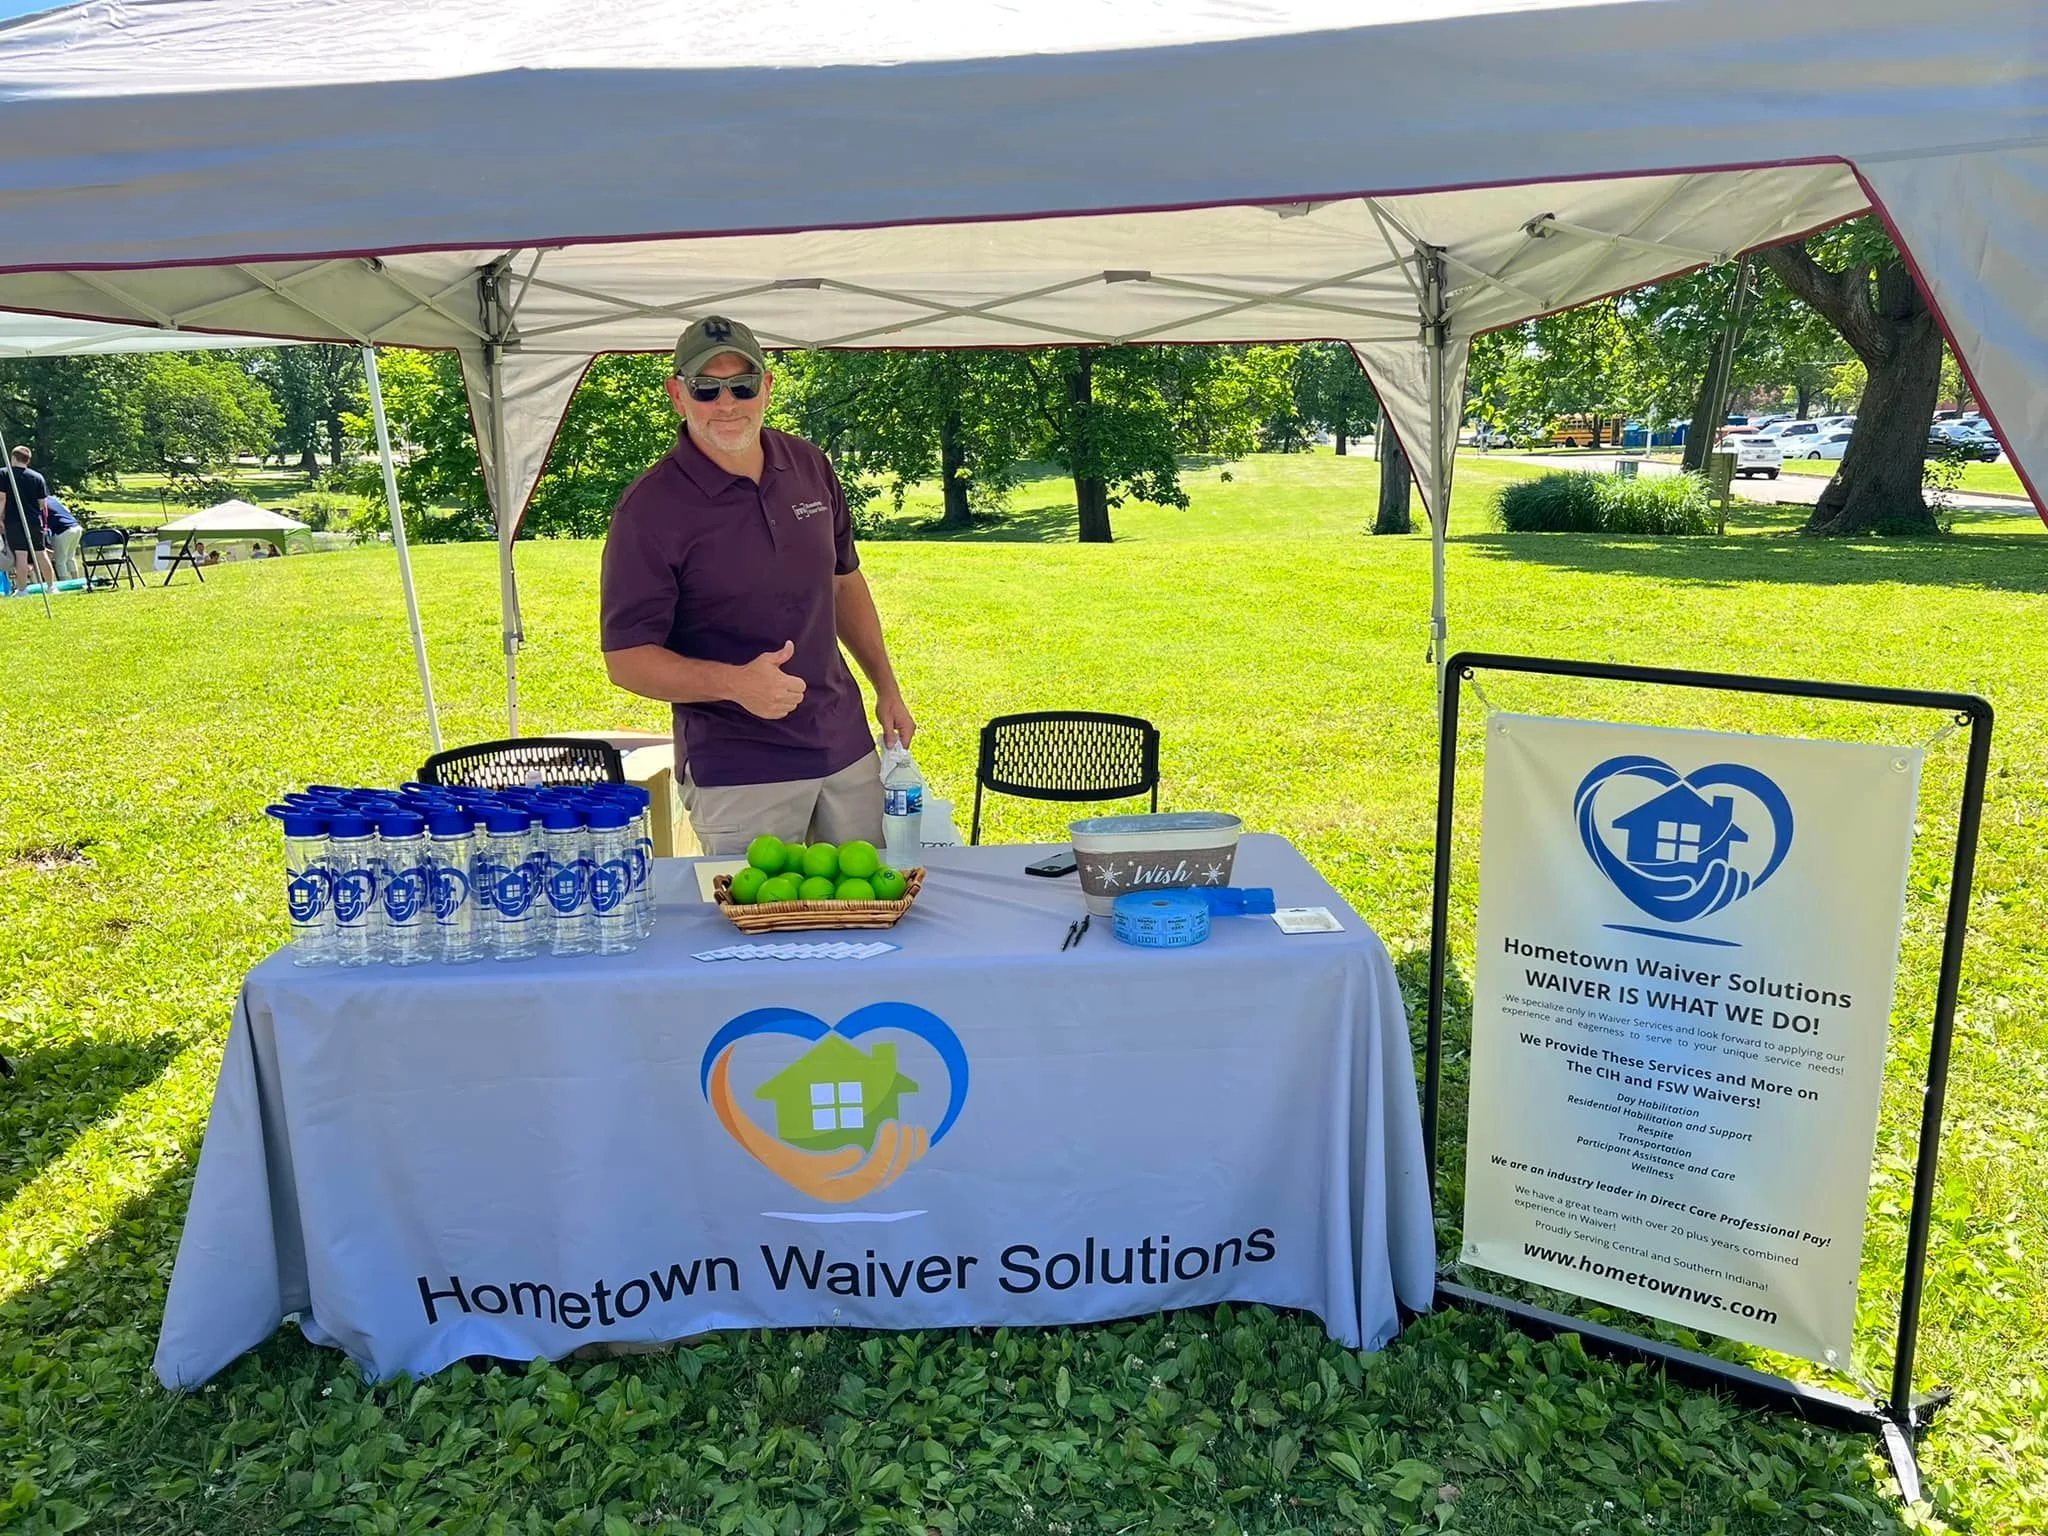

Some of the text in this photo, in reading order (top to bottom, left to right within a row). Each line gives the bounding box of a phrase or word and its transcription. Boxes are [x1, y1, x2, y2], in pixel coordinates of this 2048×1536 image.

[1134, 860, 1192, 885] Wish
[1504, 937, 1852, 1008] Hometown Waiver Solutions
[1525, 969, 1820, 1035] WAIVER IS WHAT WE DO!
[1502, 1006, 1844, 1076] experience and eagerness to serve to your unique service needs!
[1521, 997, 1564, 1012] specialize
[1566, 1007, 1585, 1017] only
[1588, 1010, 1596, 1018] in
[1599, 1012, 1631, 1025] Waiver
[1633, 1018, 1673, 1032] Services
[1675, 1025, 1695, 1035] and
[1697, 1028, 1718, 1039] look
[1721, 1033, 1761, 1048] forward
[1765, 1041, 1775, 1050] to
[1778, 1045, 1823, 1061] applying
[1826, 1052, 1845, 1062] our
[1520, 1032, 1819, 1102] We Provide These Services and More on
[1566, 1060, 1761, 1109] The CIH and FSW Waivers!
[1568, 1095, 1752, 1142] Residential Habilitation and Support
[1617, 1093, 1700, 1117] Day Habilitation
[1637, 1124, 1674, 1141] Respite
[1577, 1136, 1736, 1181] Participant Assistance and Care
[1618, 1132, 1692, 1158] Transportation
[1632, 1162, 1674, 1180] Wellness
[1491, 1155, 1831, 1248] We are an industry leader in Direct Care Professional Pay!
[1515, 1198, 1616, 1231] experience in Waiver!
[1515, 1185, 1530, 1195] We
[1532, 1187, 1555, 1201] have
[1565, 1200, 1591, 1211] great
[1593, 1206, 1618, 1219] team
[1621, 1213, 1642, 1224] with
[1646, 1222, 1668, 1231] over
[1671, 1225, 1684, 1235] 20
[1687, 1230, 1708, 1242] plus
[1711, 1238, 1740, 1252] years
[1742, 1247, 1799, 1266] combined
[418, 1227, 1276, 1330] Hometown Waiver Solutions
[1524, 1242, 1778, 1324] www.hometownws.com
[1535, 1220, 1768, 1292] Proudly Serving Central and Southern Indiana!
